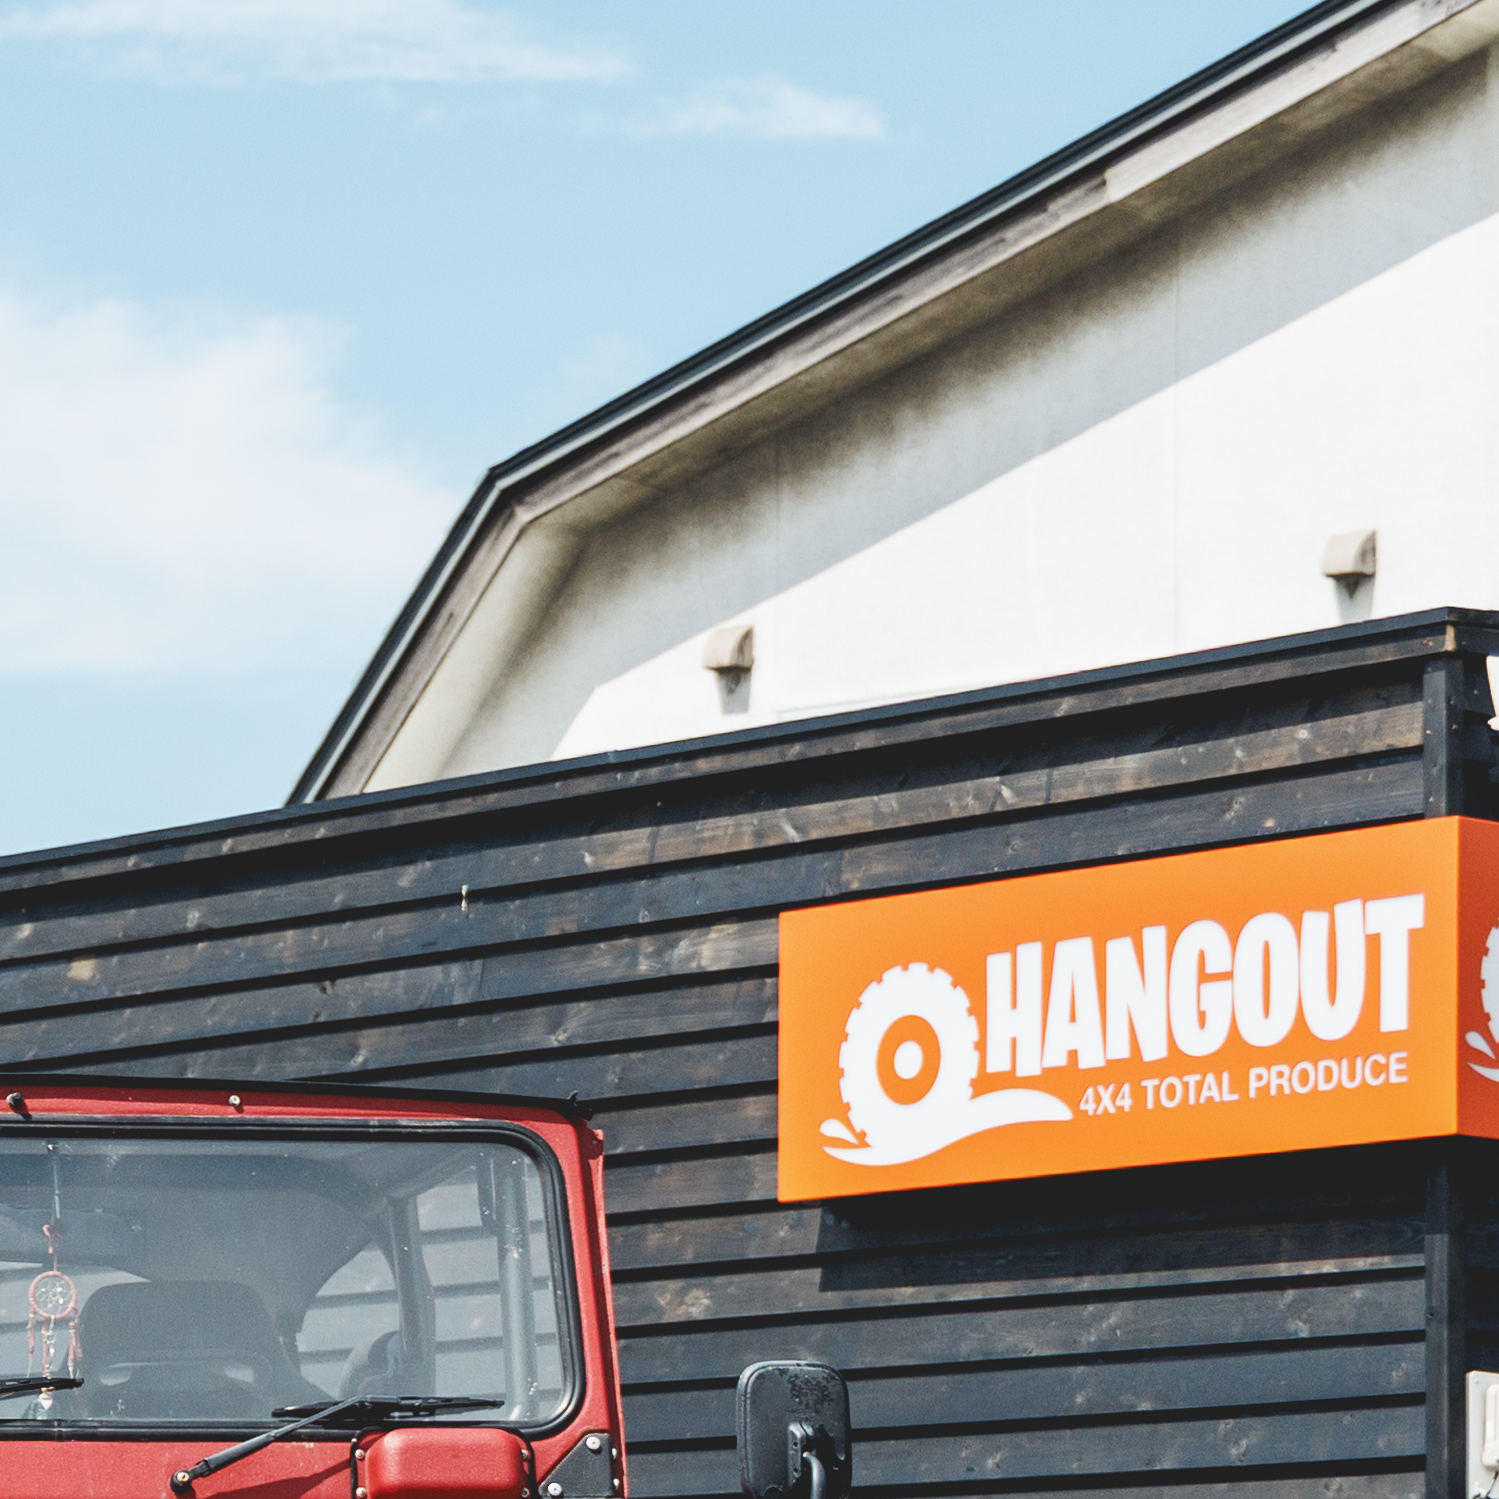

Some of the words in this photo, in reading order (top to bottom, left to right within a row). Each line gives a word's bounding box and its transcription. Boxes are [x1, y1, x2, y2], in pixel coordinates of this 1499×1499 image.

[985, 892, 1427, 1078] HANGOUT
[1078, 1082, 1133, 1116] 4X4
[1140, 1072, 1240, 1110] TOTAL
[1249, 1050, 1409, 1099] PRODUCE
